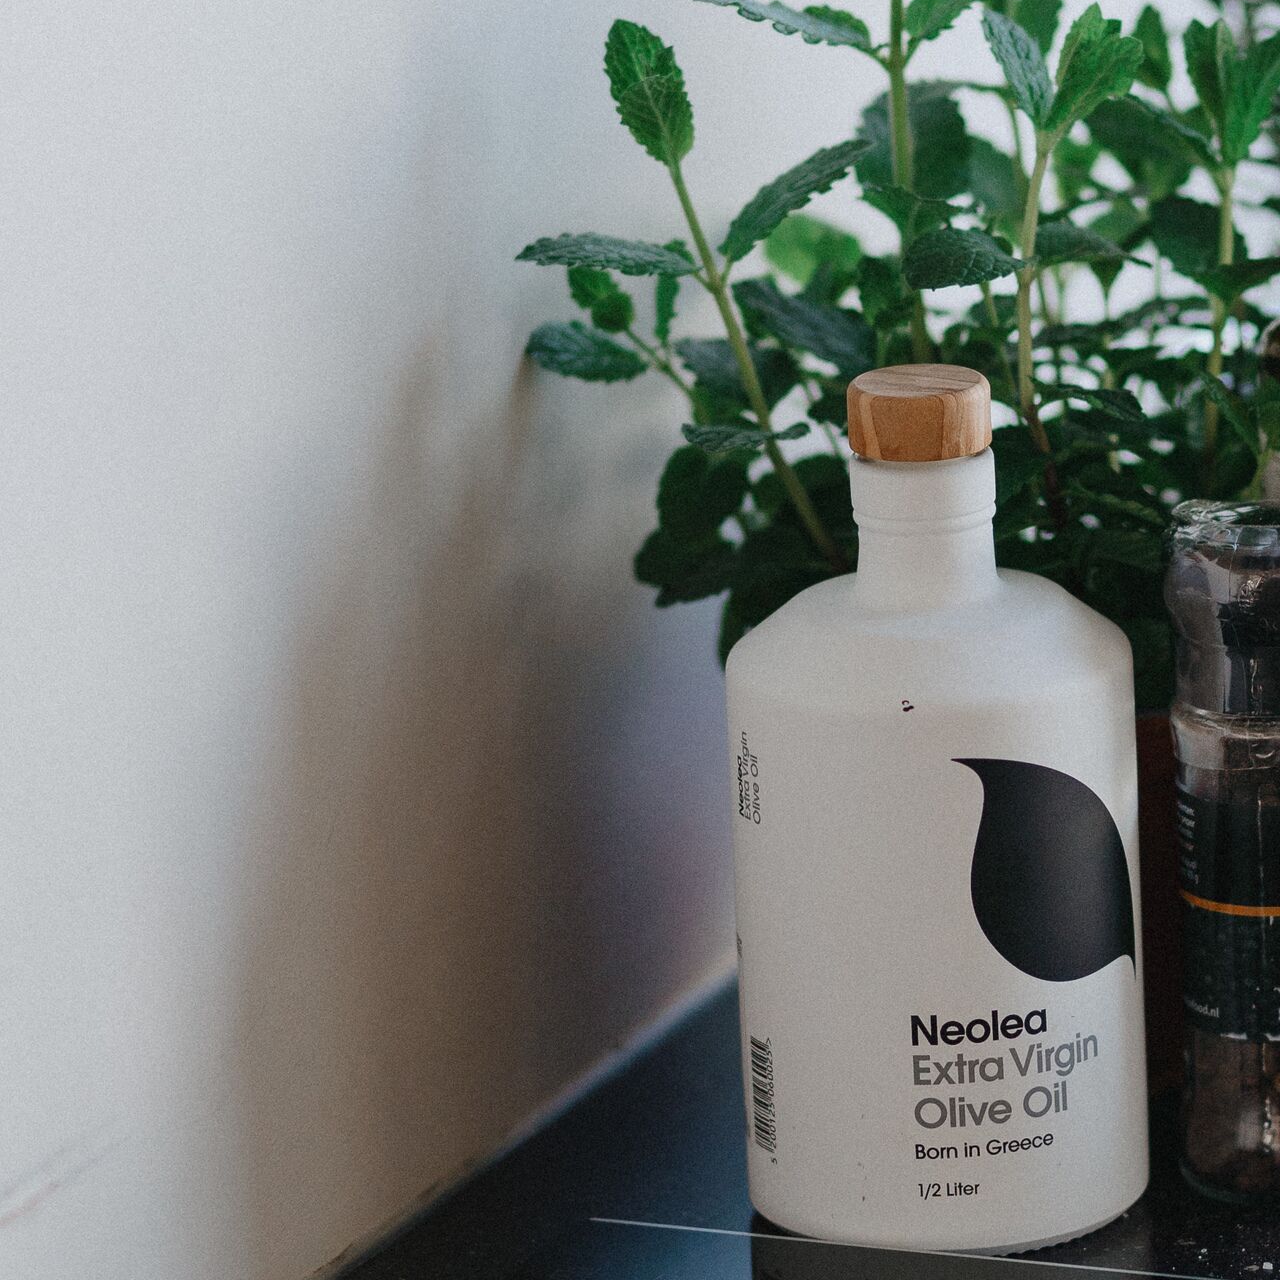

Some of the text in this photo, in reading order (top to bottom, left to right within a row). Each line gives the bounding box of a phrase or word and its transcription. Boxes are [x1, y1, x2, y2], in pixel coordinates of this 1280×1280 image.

[737, 754, 745, 817] Neolea
[741, 731, 752, 820] Extra Virgin
[750, 754, 761, 825] Olive Oil
[910, 1008, 1047, 1046] Neolea
[912, 1032, 1098, 1086] Extra Virgin
[914, 1080, 1068, 1129] Olive Oil
[771, 1157, 778, 1165] 5
[915, 1133, 1054, 1159] Born in Greece
[918, 1182, 980, 1200] 1/2 Liter
